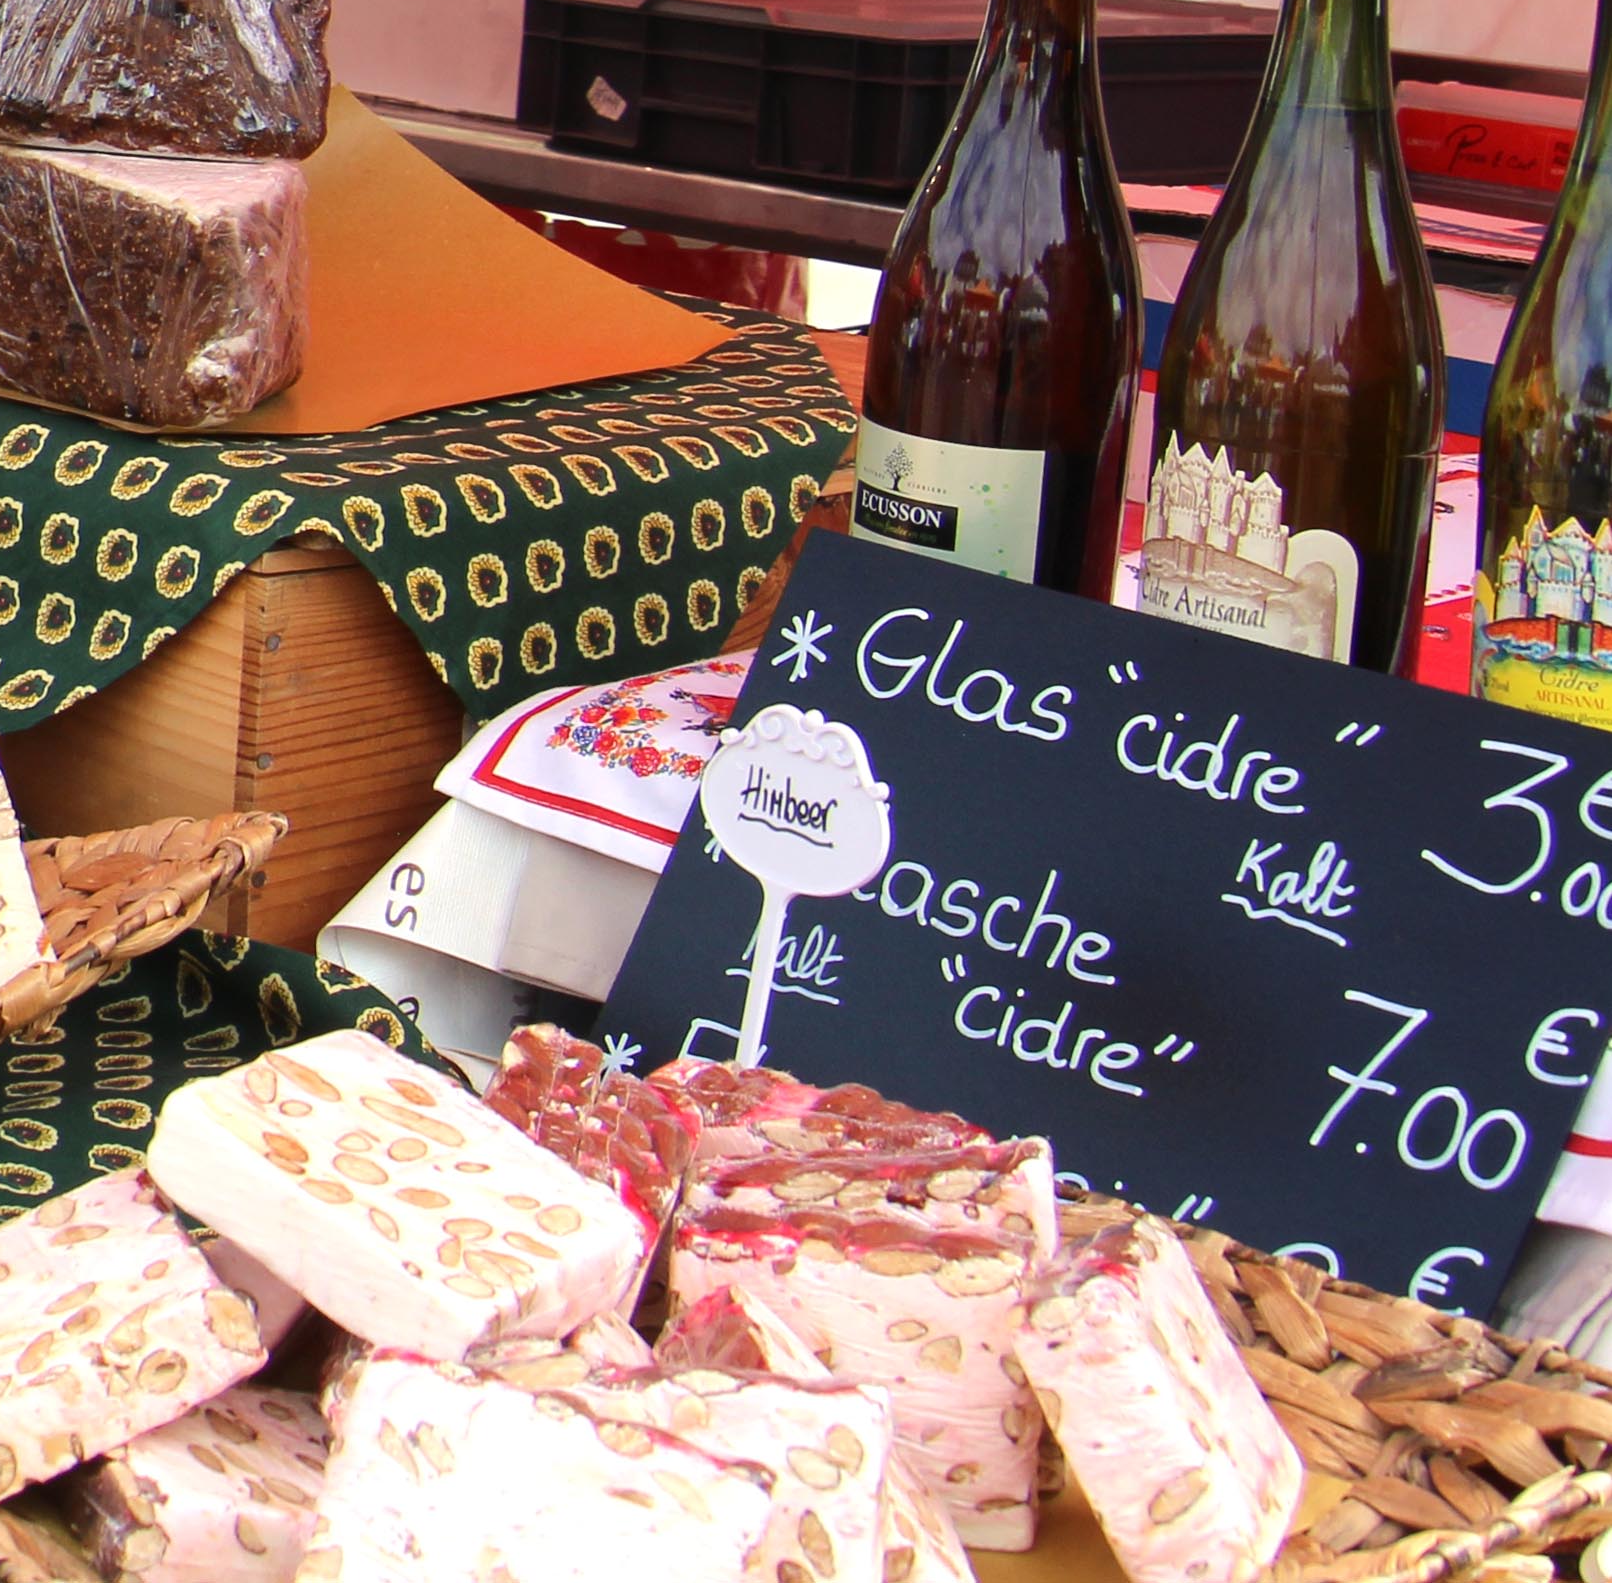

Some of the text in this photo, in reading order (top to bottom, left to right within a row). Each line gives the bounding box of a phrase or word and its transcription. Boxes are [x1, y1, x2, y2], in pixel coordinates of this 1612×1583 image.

[861, 489, 943, 530] ECUSSON
[1173, 584, 1267, 629] Artisanal
[855, 607, 1075, 742] Glas
[1538, 664, 1601, 693] Cidre
[1234, 839, 1358, 922] Kalt
[850, 869, 1117, 992] asche
[1524, 1007, 1599, 1086] €
